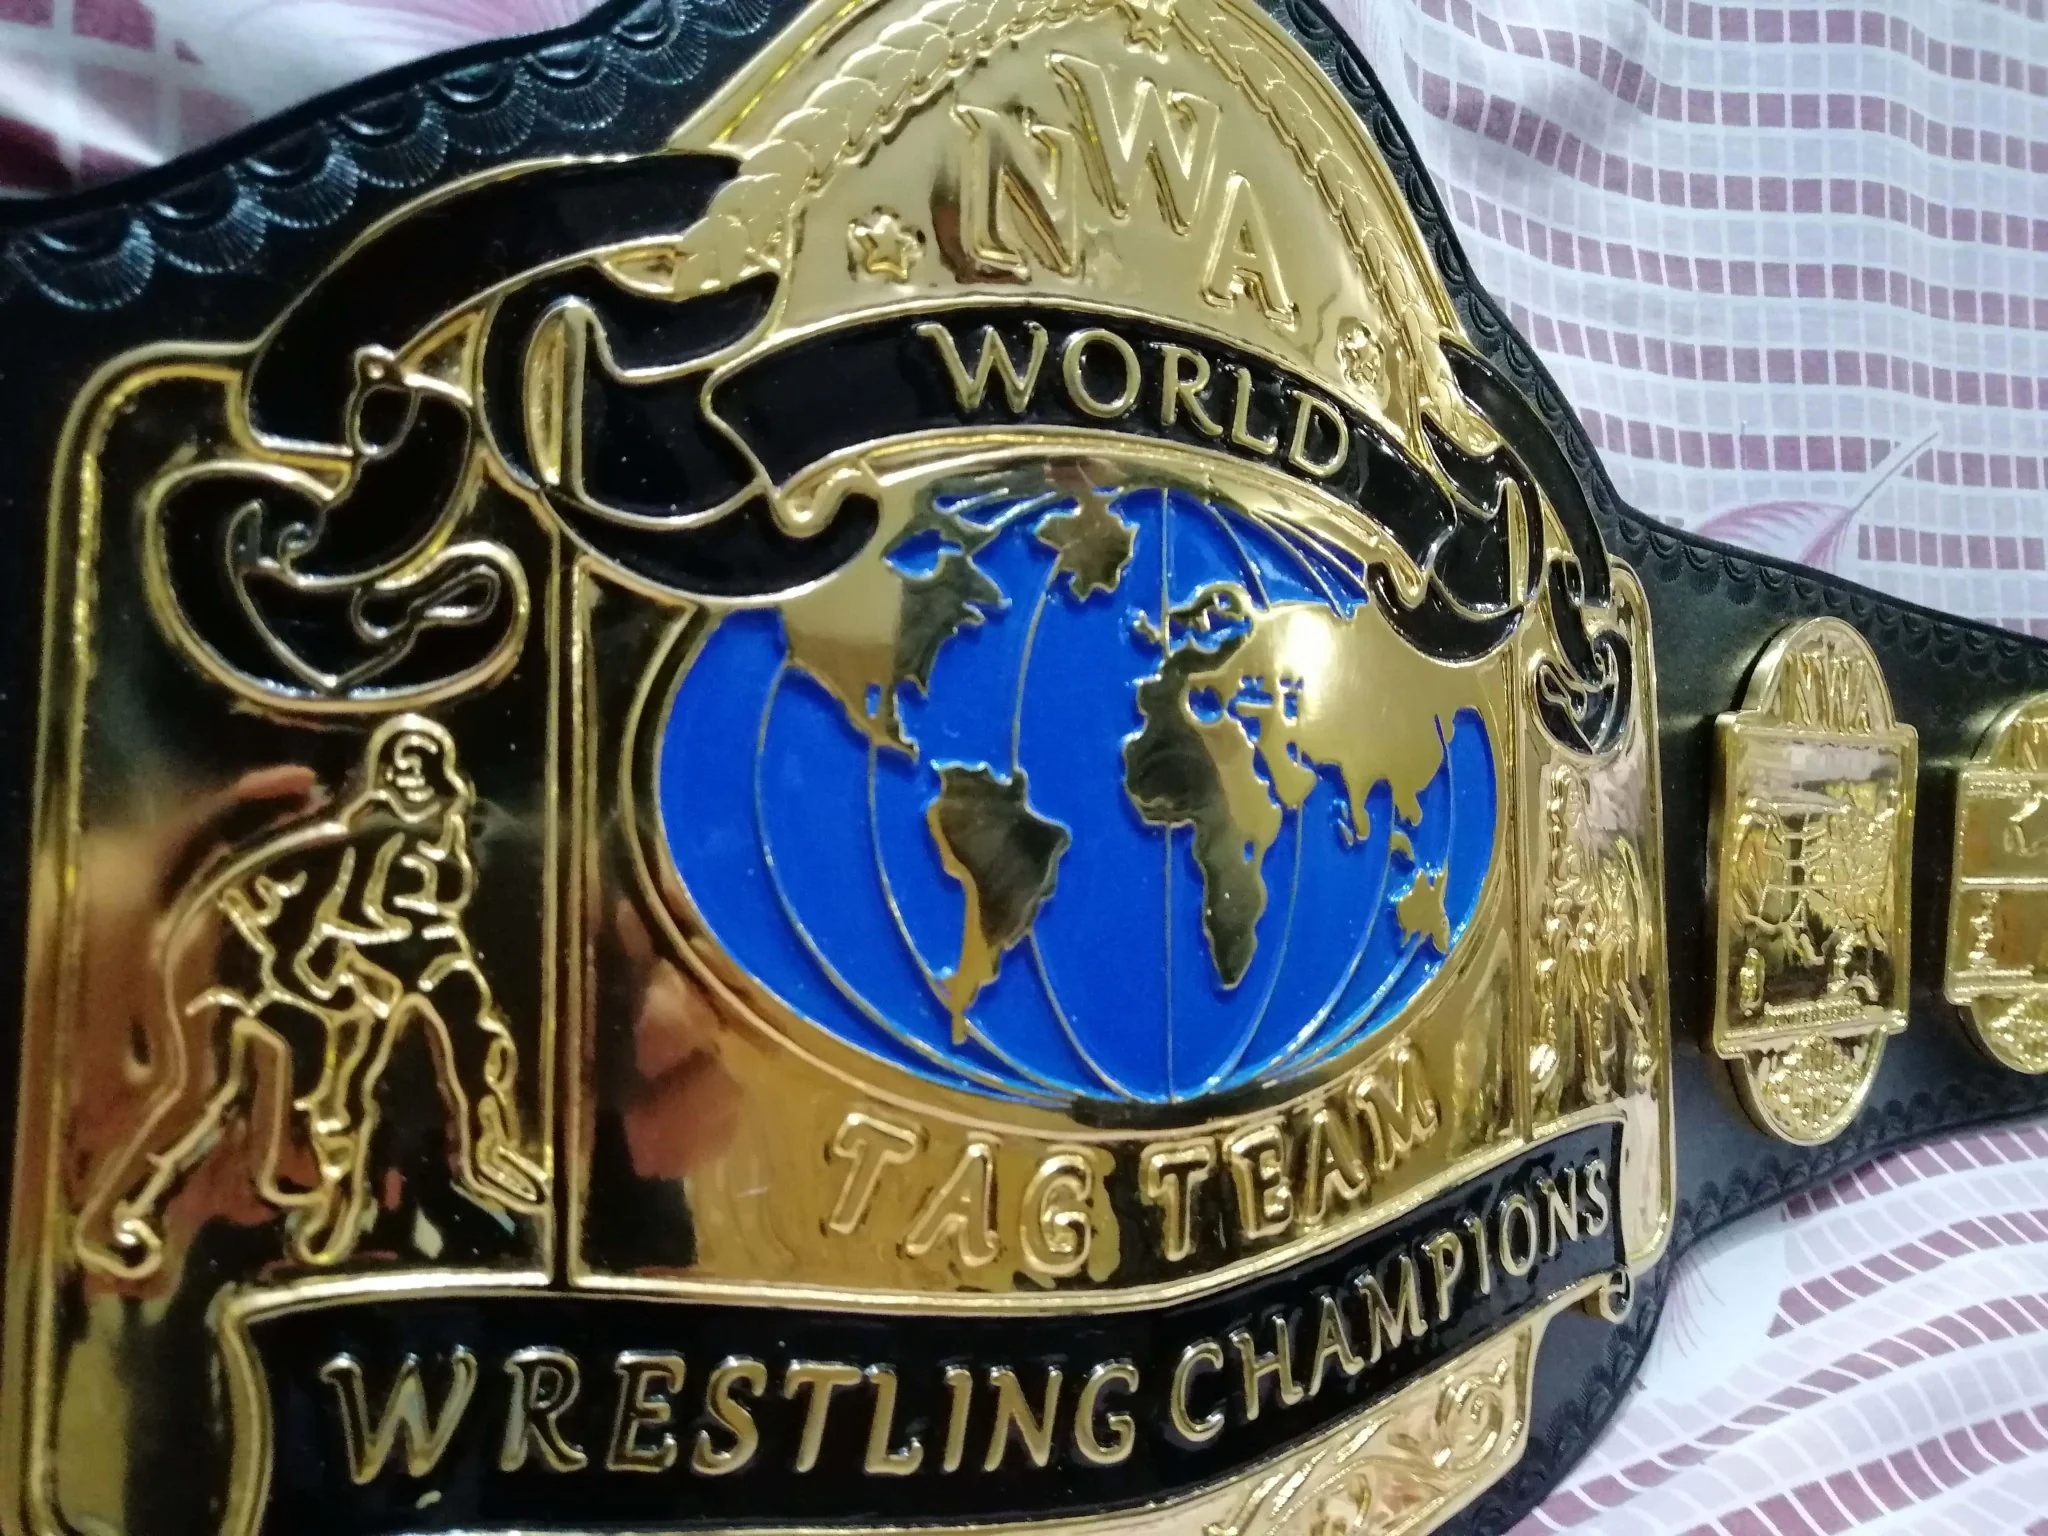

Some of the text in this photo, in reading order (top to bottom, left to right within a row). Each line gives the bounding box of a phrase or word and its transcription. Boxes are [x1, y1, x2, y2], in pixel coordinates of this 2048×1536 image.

[949, 49, 1299, 332] NWA
[916, 321, 1350, 477] WORLD
[829, 1038, 1440, 1276] TAG TEAM
[320, 1155, 1609, 1485] WRESTLING CHAMPIONS
